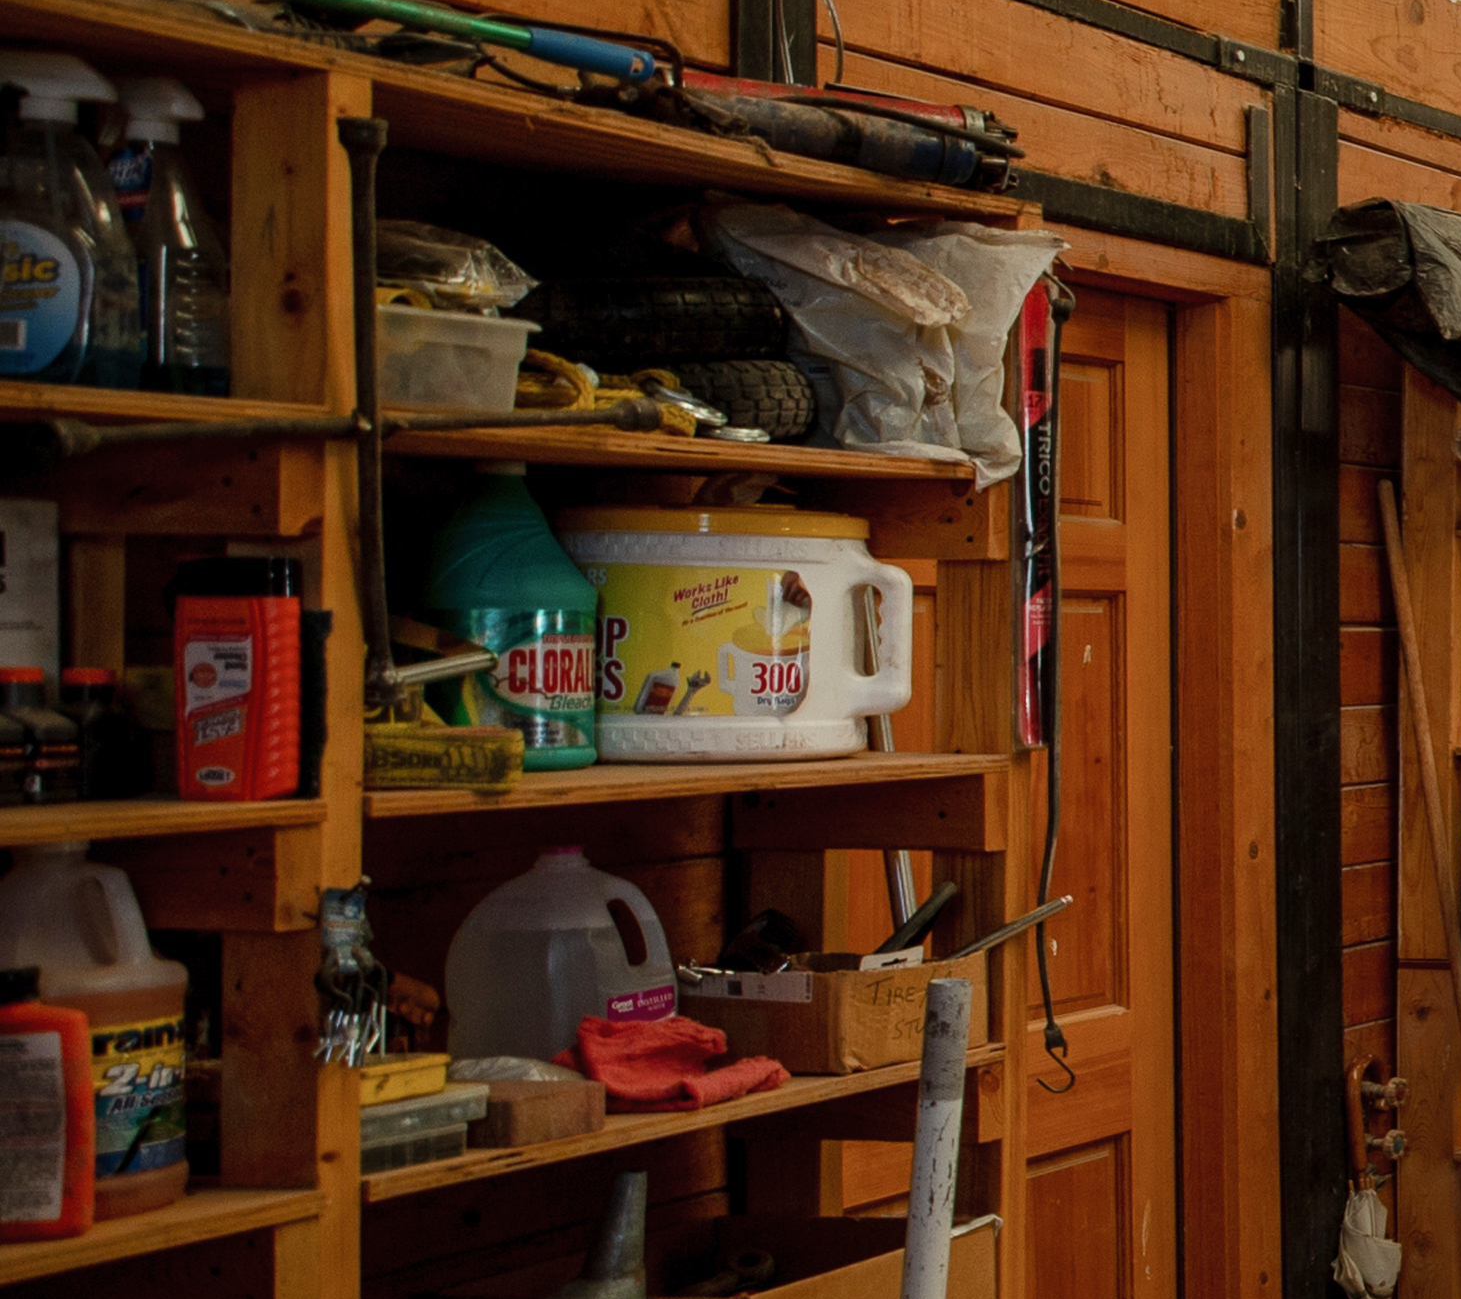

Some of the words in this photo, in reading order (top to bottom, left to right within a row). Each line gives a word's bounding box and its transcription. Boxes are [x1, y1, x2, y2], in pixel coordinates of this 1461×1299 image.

[1037, 420, 1052, 496] TRICO
[673, 584, 713, 603] Works
[714, 574, 740, 592] Like
[690, 589, 730, 610] Cloth!
[508, 648, 596, 695] CLORAL
[751, 662, 802, 695] 300
[551, 693, 594, 711] Bleac
[865, 975, 916, 1007] TIRE
[92, 1017, 184, 1057] rain
[893, 1019, 925, 1042] STU
[100, 1062, 178, 1097] 2-in
